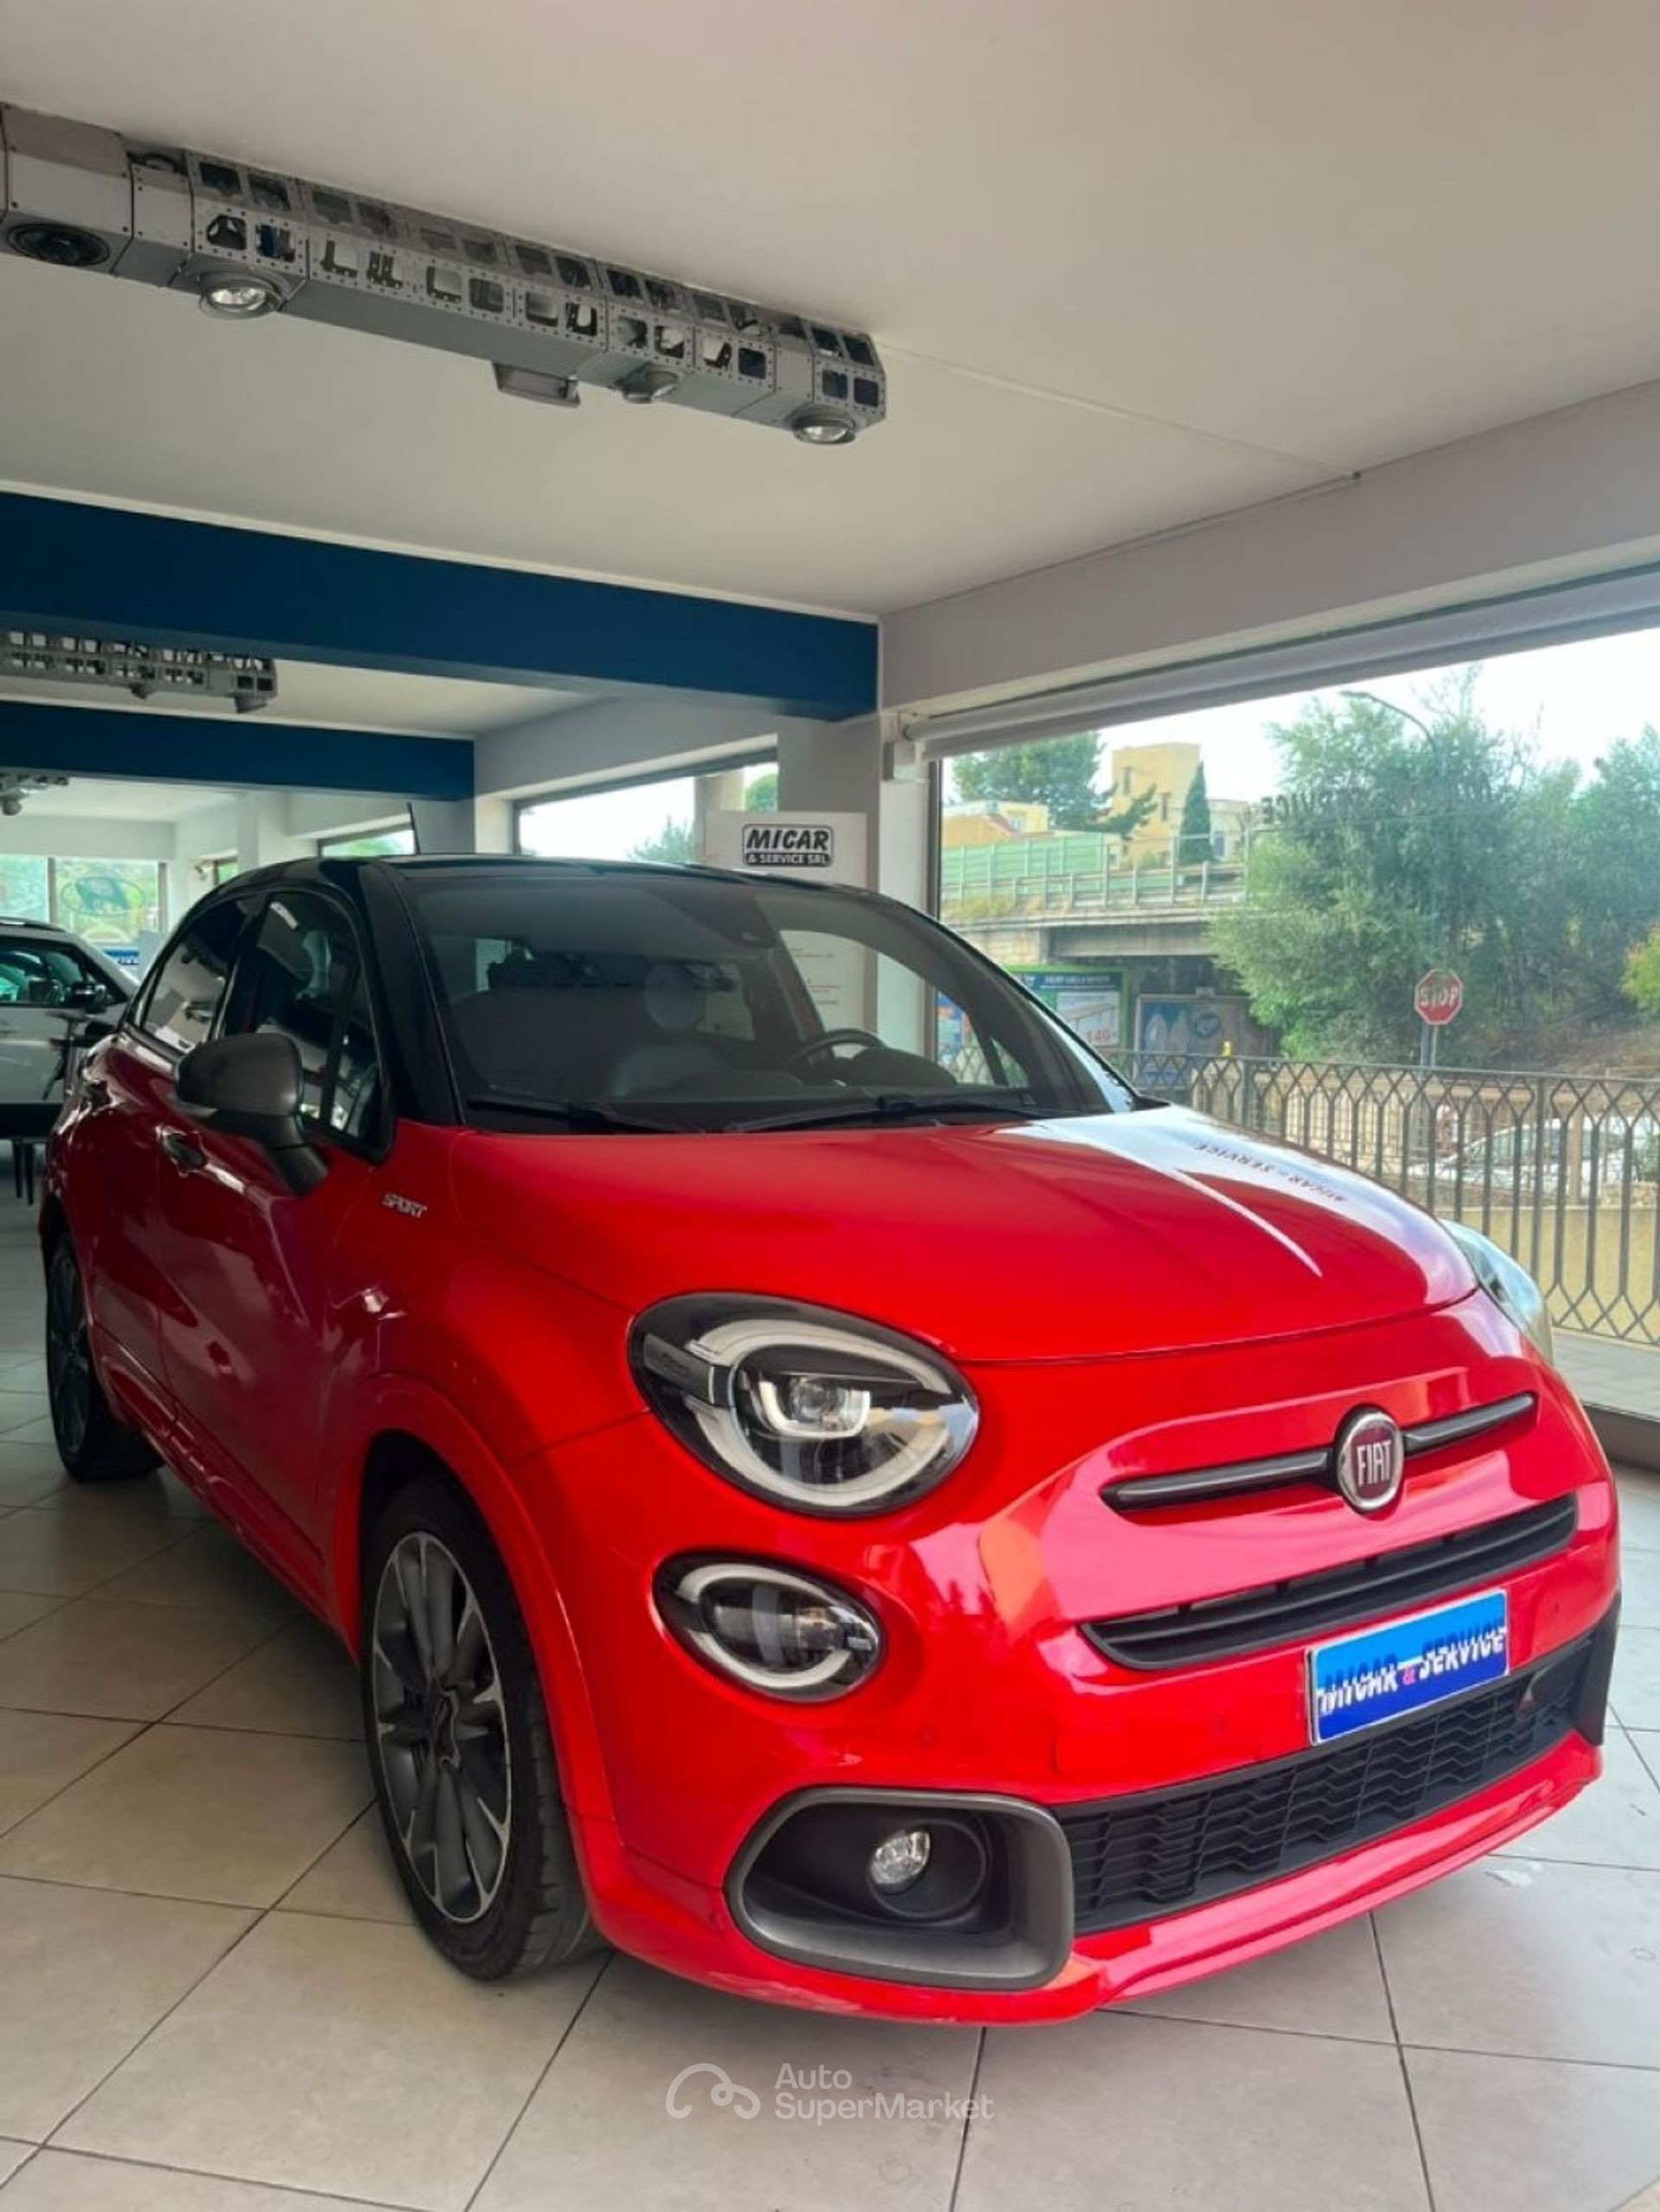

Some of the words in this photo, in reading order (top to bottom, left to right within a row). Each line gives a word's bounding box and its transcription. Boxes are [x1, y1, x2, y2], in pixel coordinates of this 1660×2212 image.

[746, 829, 829, 851] MICAR
[762, 853, 804, 864] SERVICE
[1420, 985, 1459, 1008] STOP
[381, 1193, 428, 1218] SPORT
[1357, 1439, 1391, 1487] FIAT
[1316, 1656, 1399, 1716] MICAR
[1418, 1622, 1506, 1680] SERVICE
